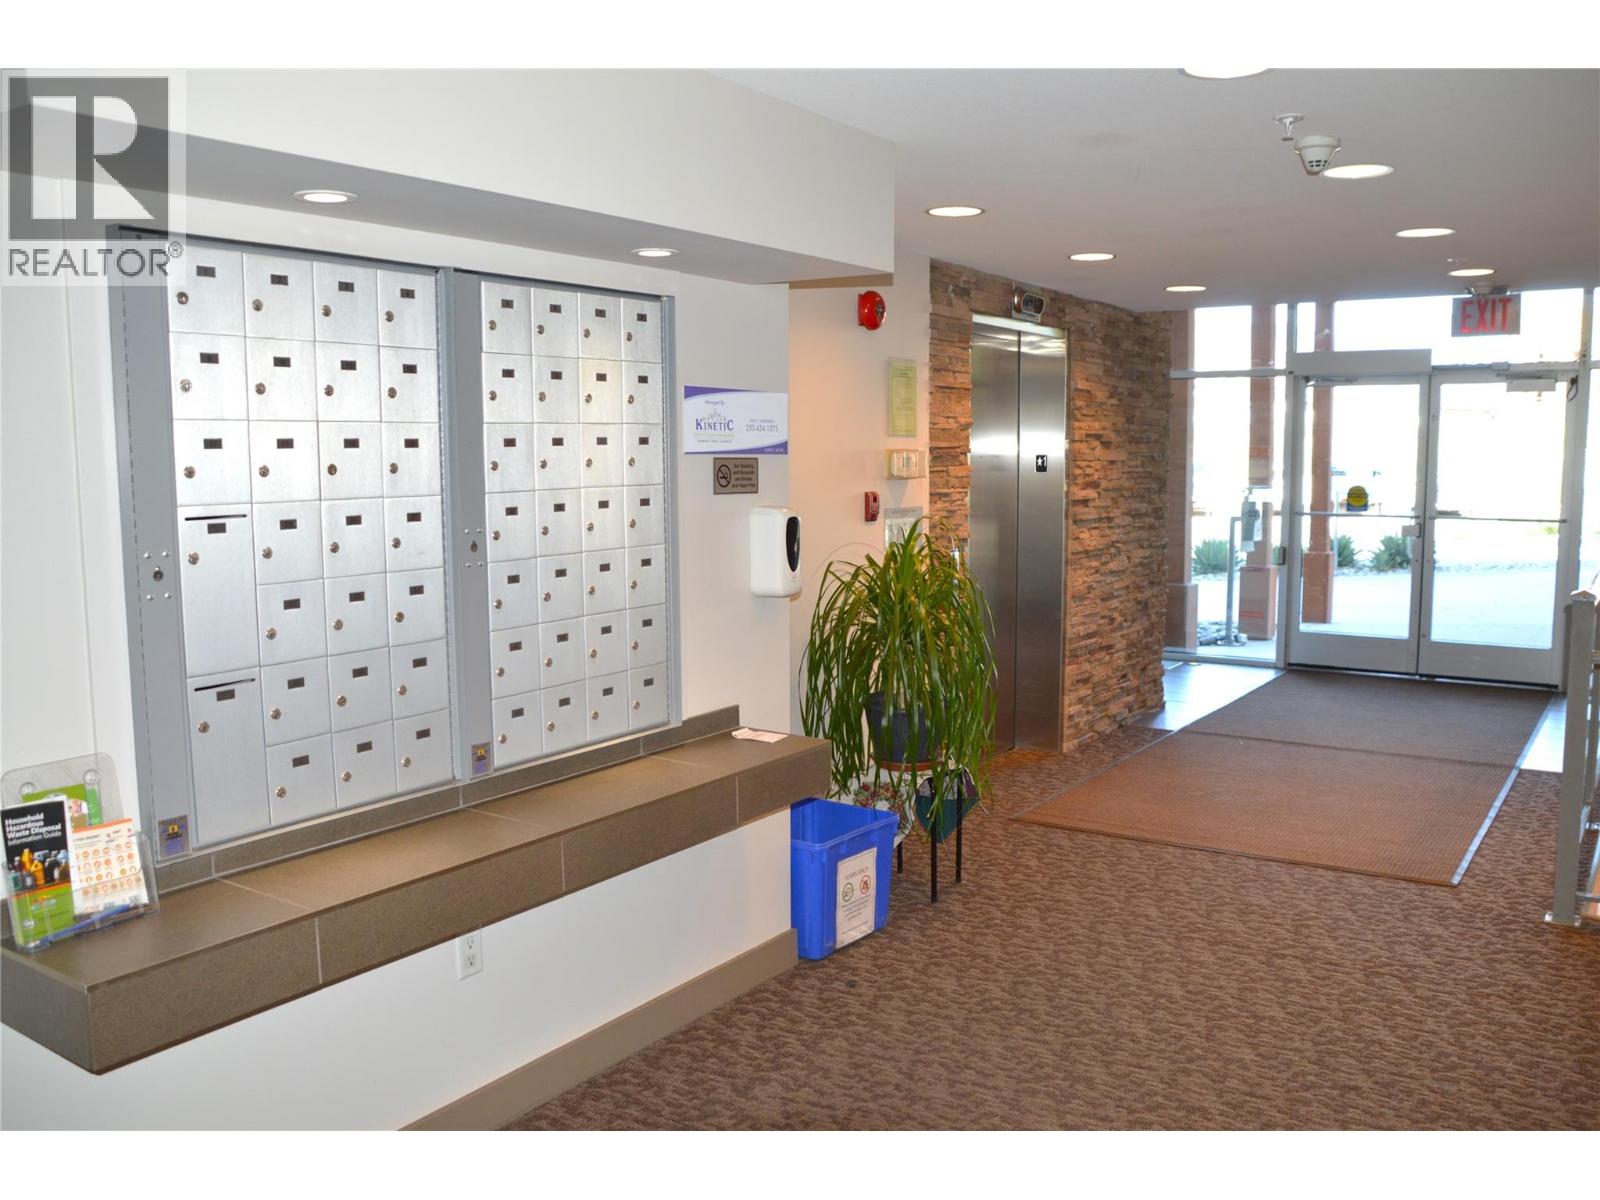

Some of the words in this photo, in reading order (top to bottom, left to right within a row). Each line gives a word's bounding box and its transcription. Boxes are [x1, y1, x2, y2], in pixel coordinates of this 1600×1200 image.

[1461, 298, 1511, 333] EXIT
[695, 418, 734, 431] KINETIC
[5, 812, 44, 826] Household
[6, 820, 45, 832] Hazardous
[7, 829, 30, 840] Waste
[30, 823, 62, 836] Disposal
[8, 834, 43, 847] Information
[43, 830, 62, 839] Guide
